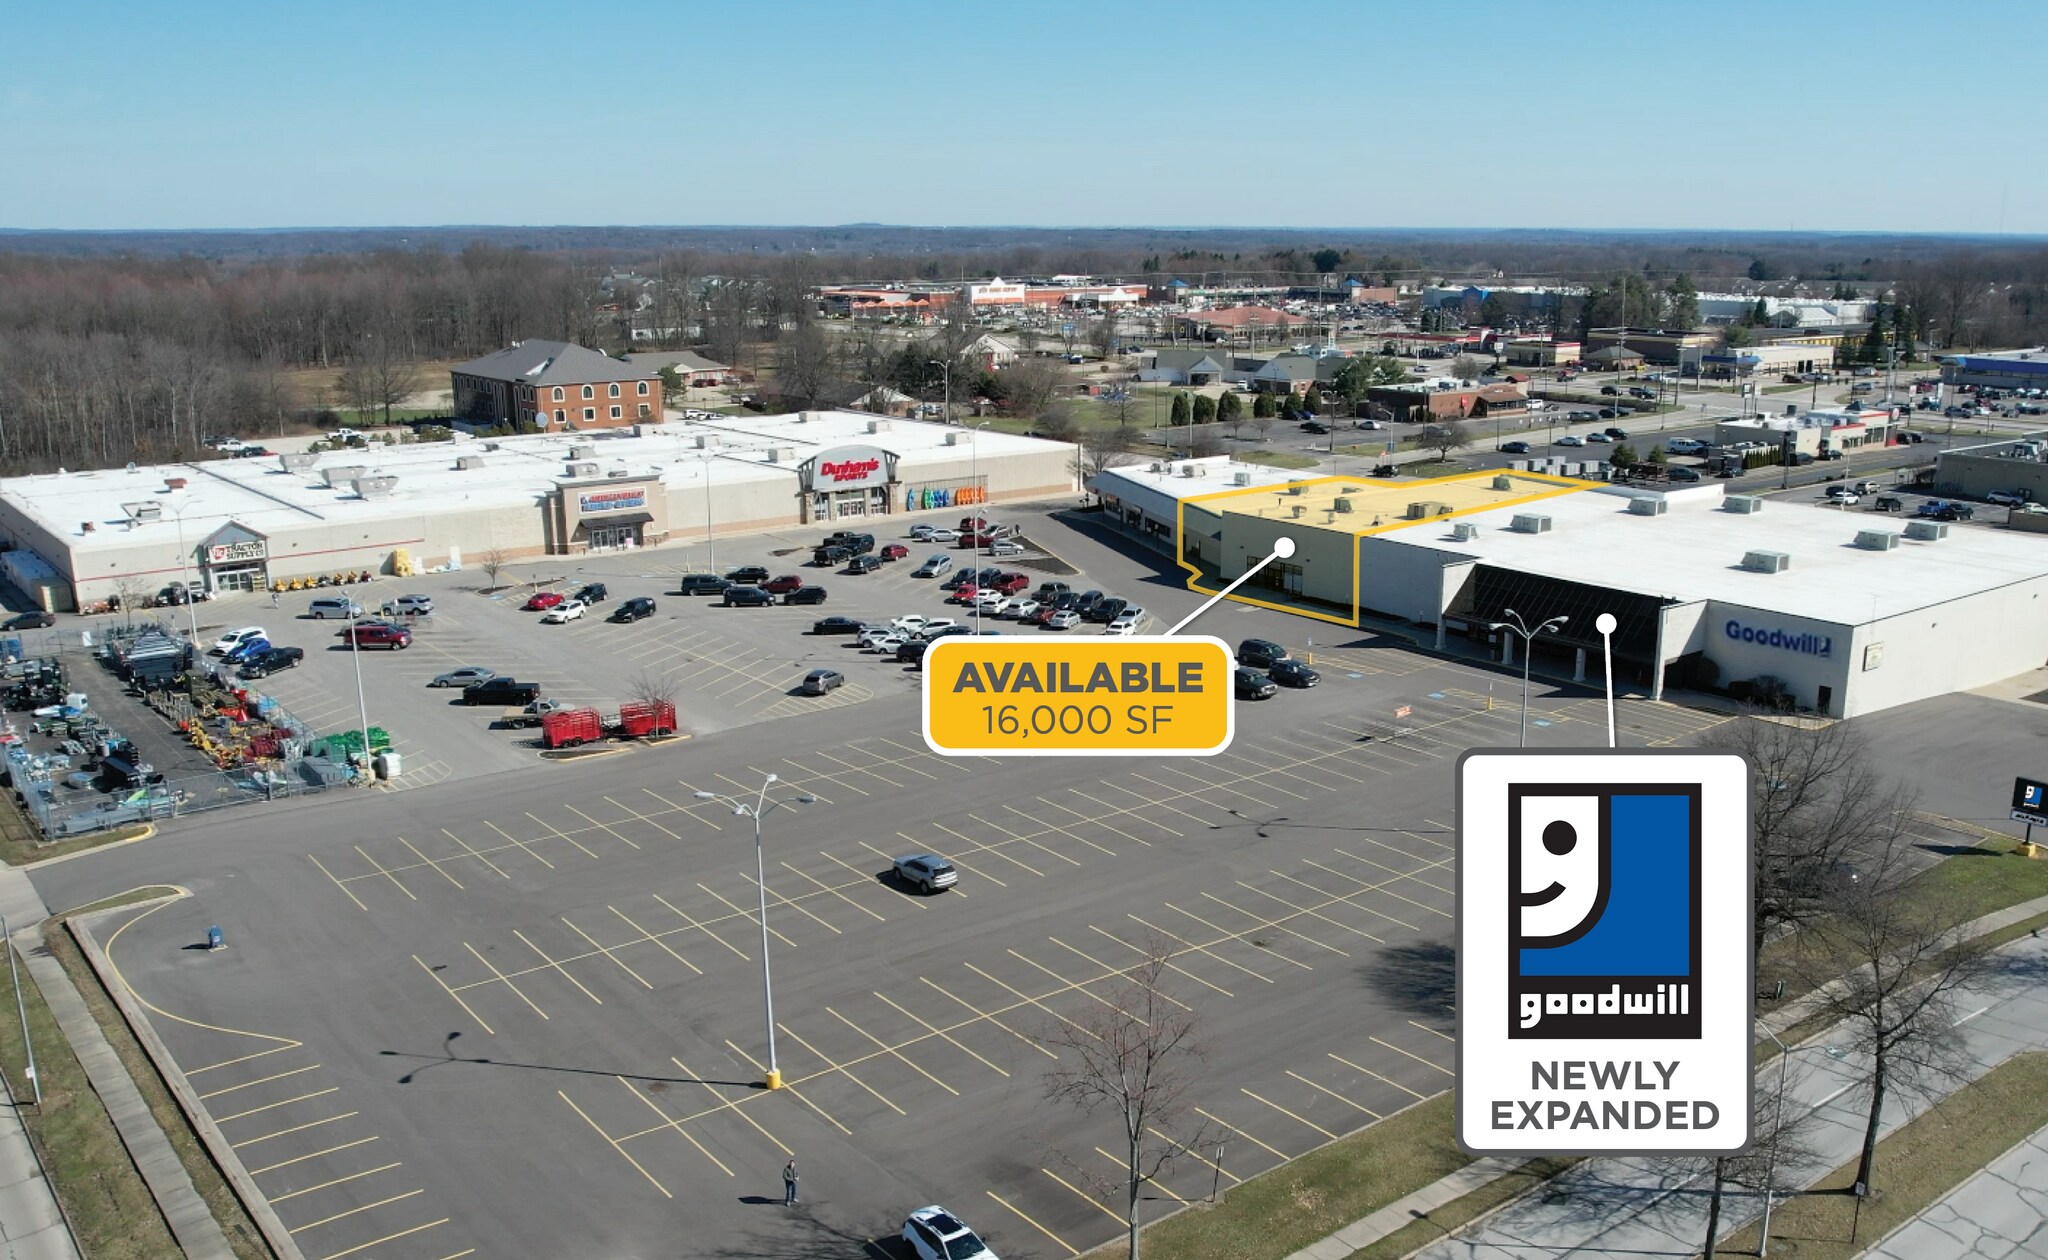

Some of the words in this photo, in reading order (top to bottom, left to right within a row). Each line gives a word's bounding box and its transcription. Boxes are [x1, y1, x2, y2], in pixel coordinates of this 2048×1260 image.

[821, 458, 880, 476] Dunham's
[226, 542, 263, 552] TRACTOR
[1726, 620, 1818, 656] Goodwill
